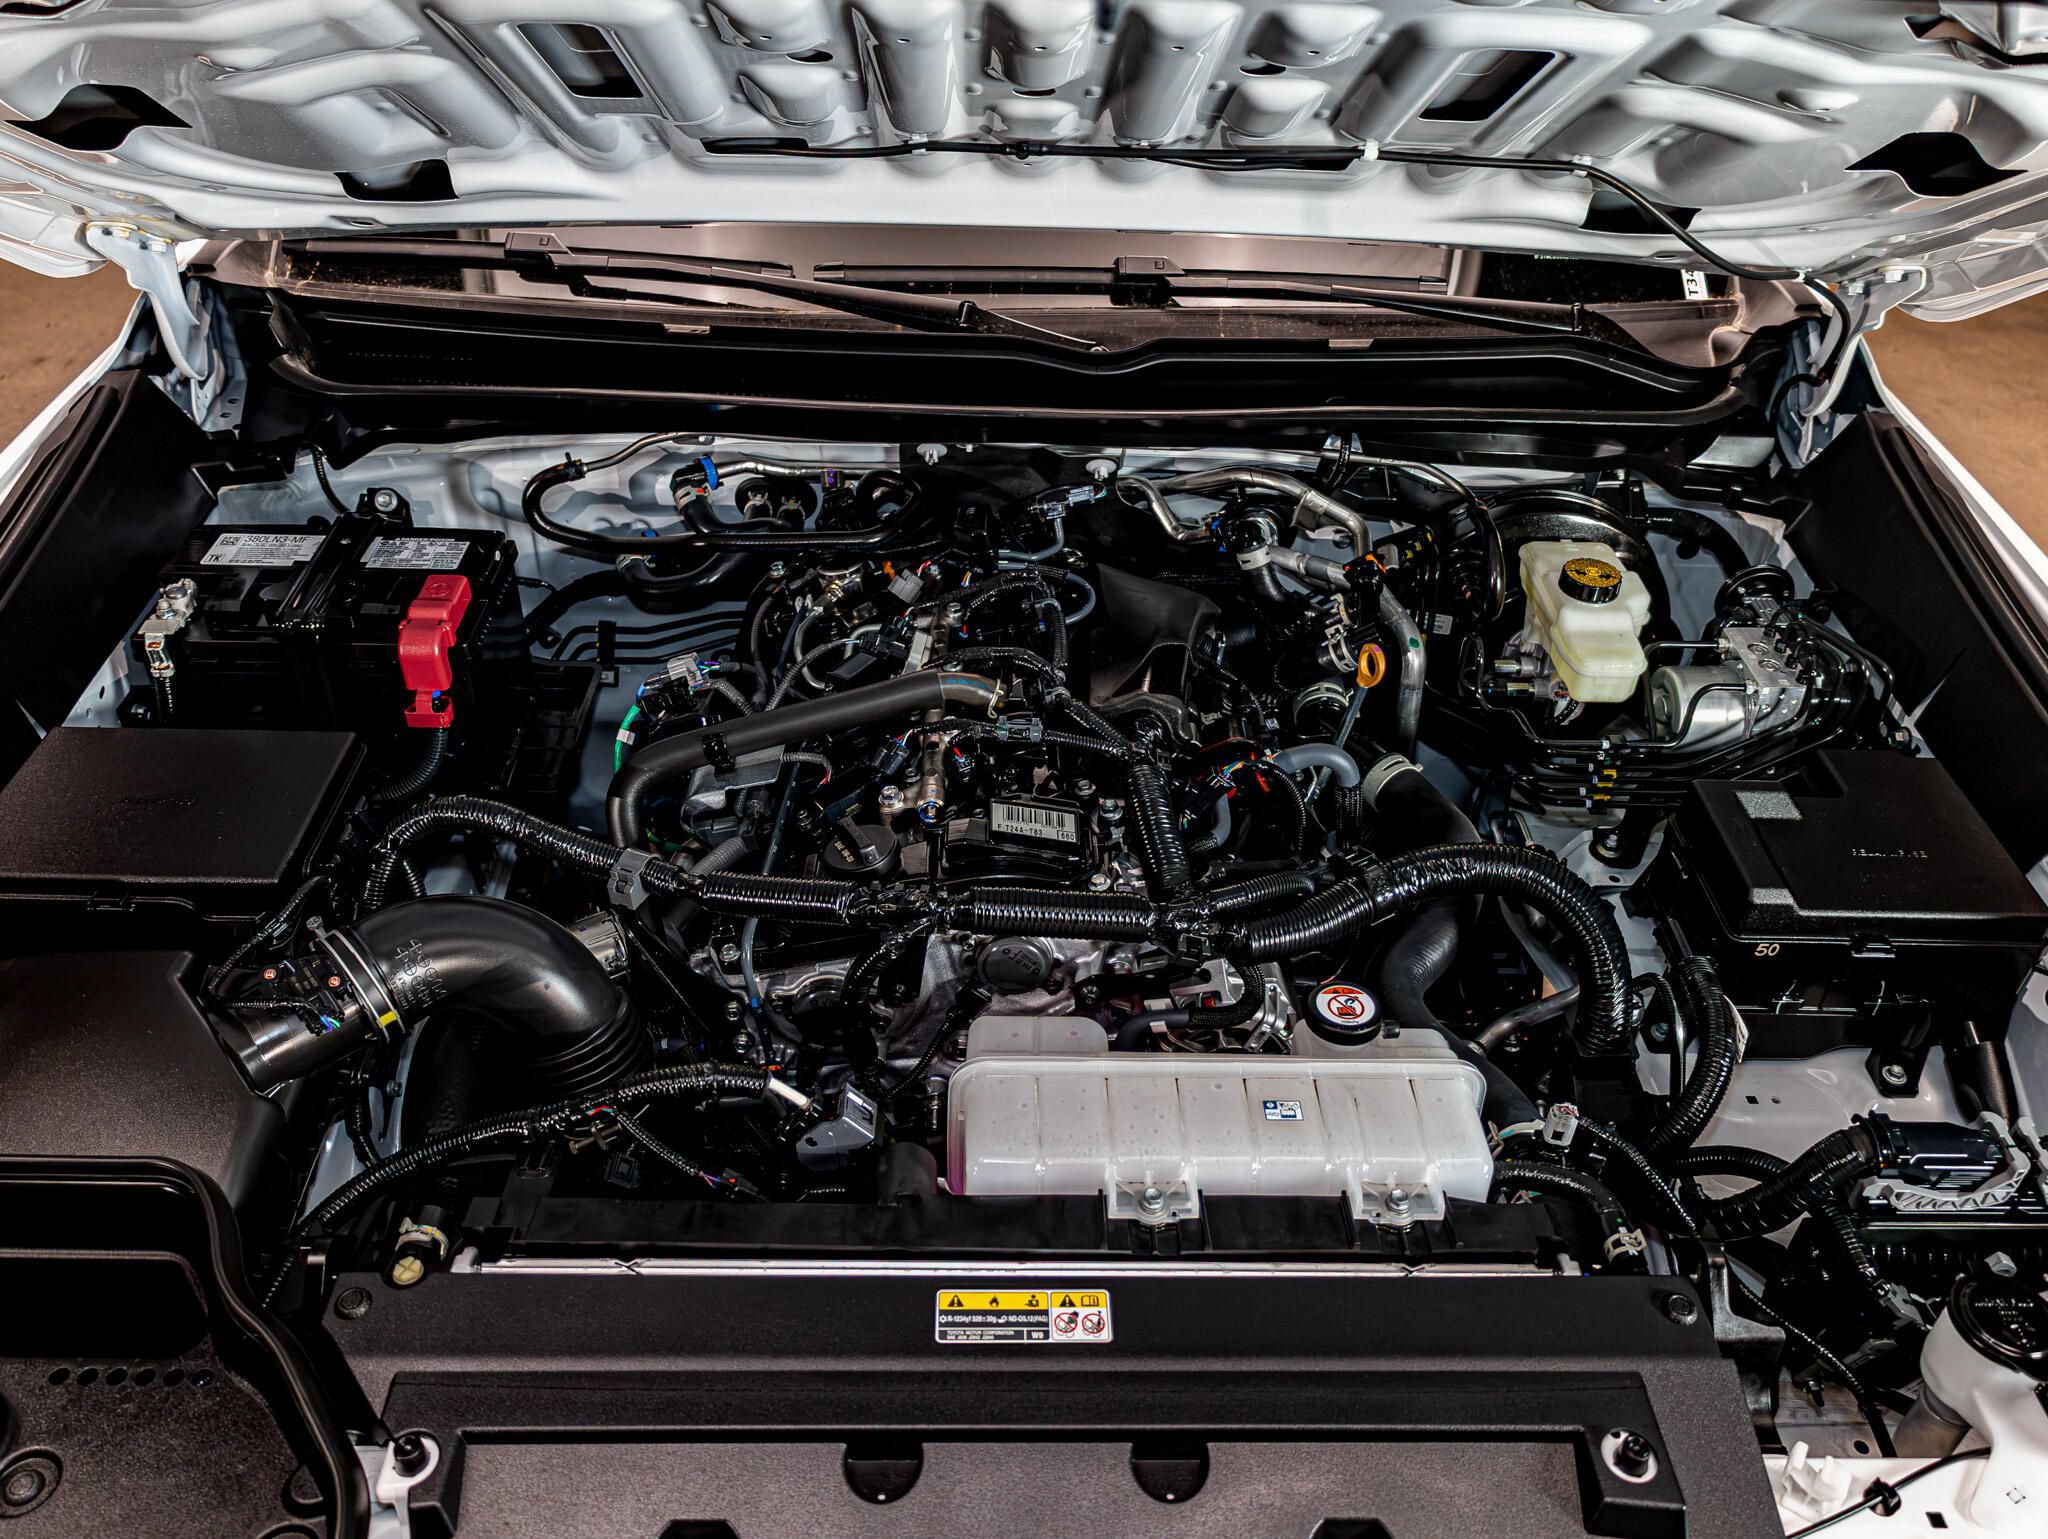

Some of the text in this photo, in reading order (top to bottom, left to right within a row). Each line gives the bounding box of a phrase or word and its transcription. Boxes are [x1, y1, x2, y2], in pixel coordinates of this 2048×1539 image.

[208, 554, 221, 562] TK
[1754, 943, 1780, 957] 50
[1031, 1331, 1044, 1340] W9
